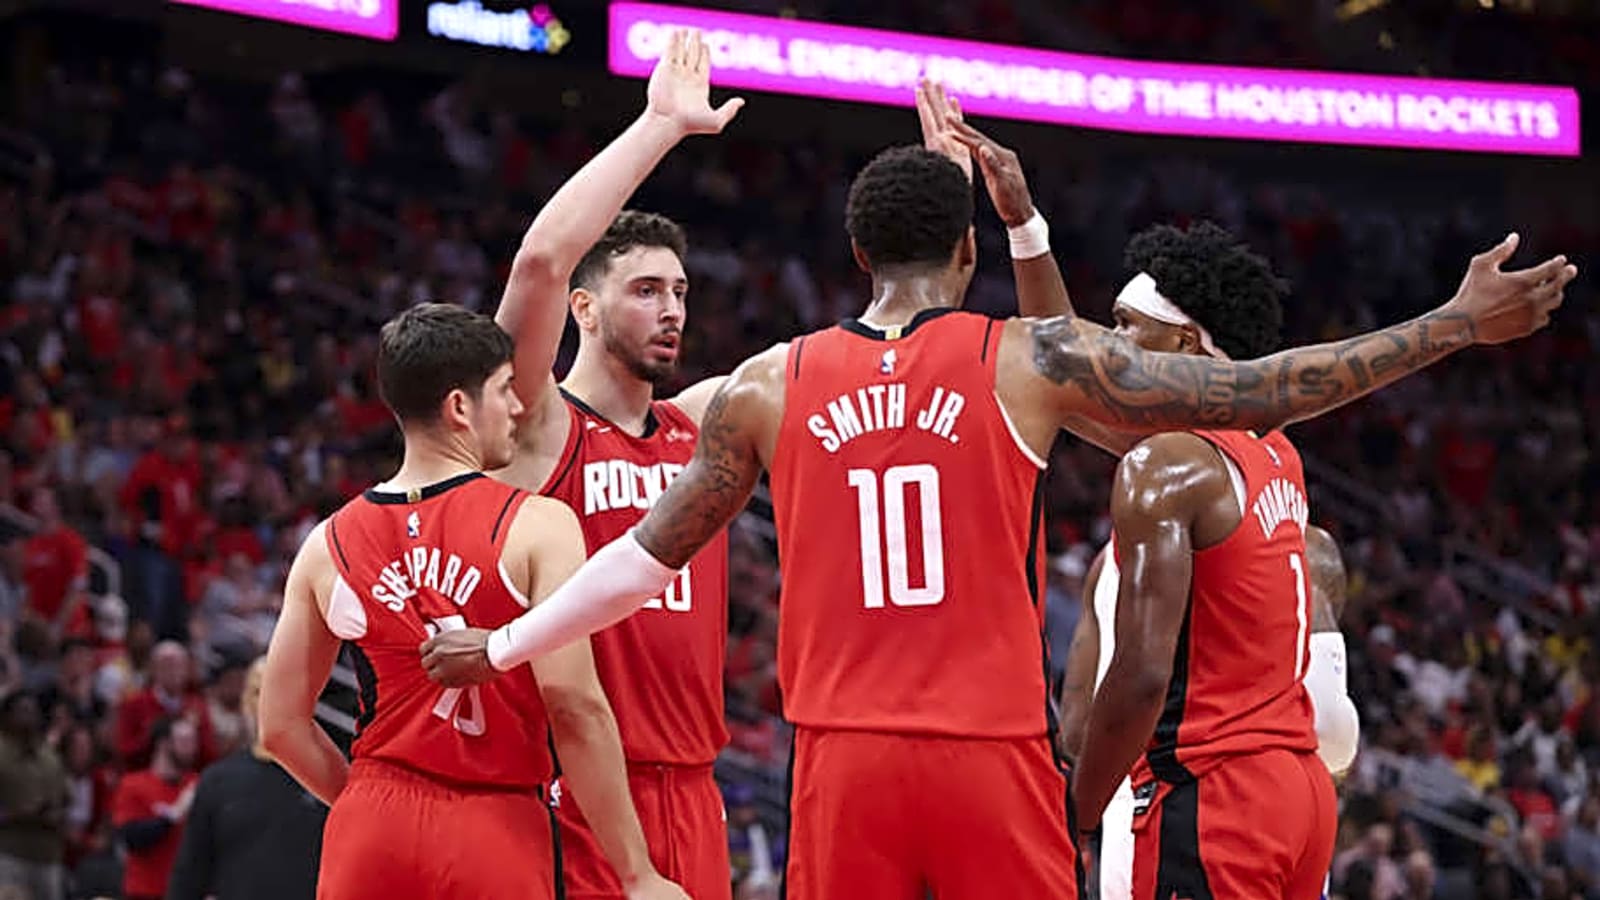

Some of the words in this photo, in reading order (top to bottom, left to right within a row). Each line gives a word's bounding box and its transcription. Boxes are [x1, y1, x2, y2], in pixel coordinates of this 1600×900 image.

[627, 20, 788, 74] OFCIAL
[1089, 72, 1132, 112] OF
[1135, 78, 1212, 118] THE
[1216, 83, 1393, 128] HOUSTON
[1397, 93, 1559, 138] ROCKETS
[807, 383, 906, 453] SMITH
[917, 386, 965, 443] JR.
[848, 464, 945, 608] 10
[1290, 553, 1307, 680] 1
